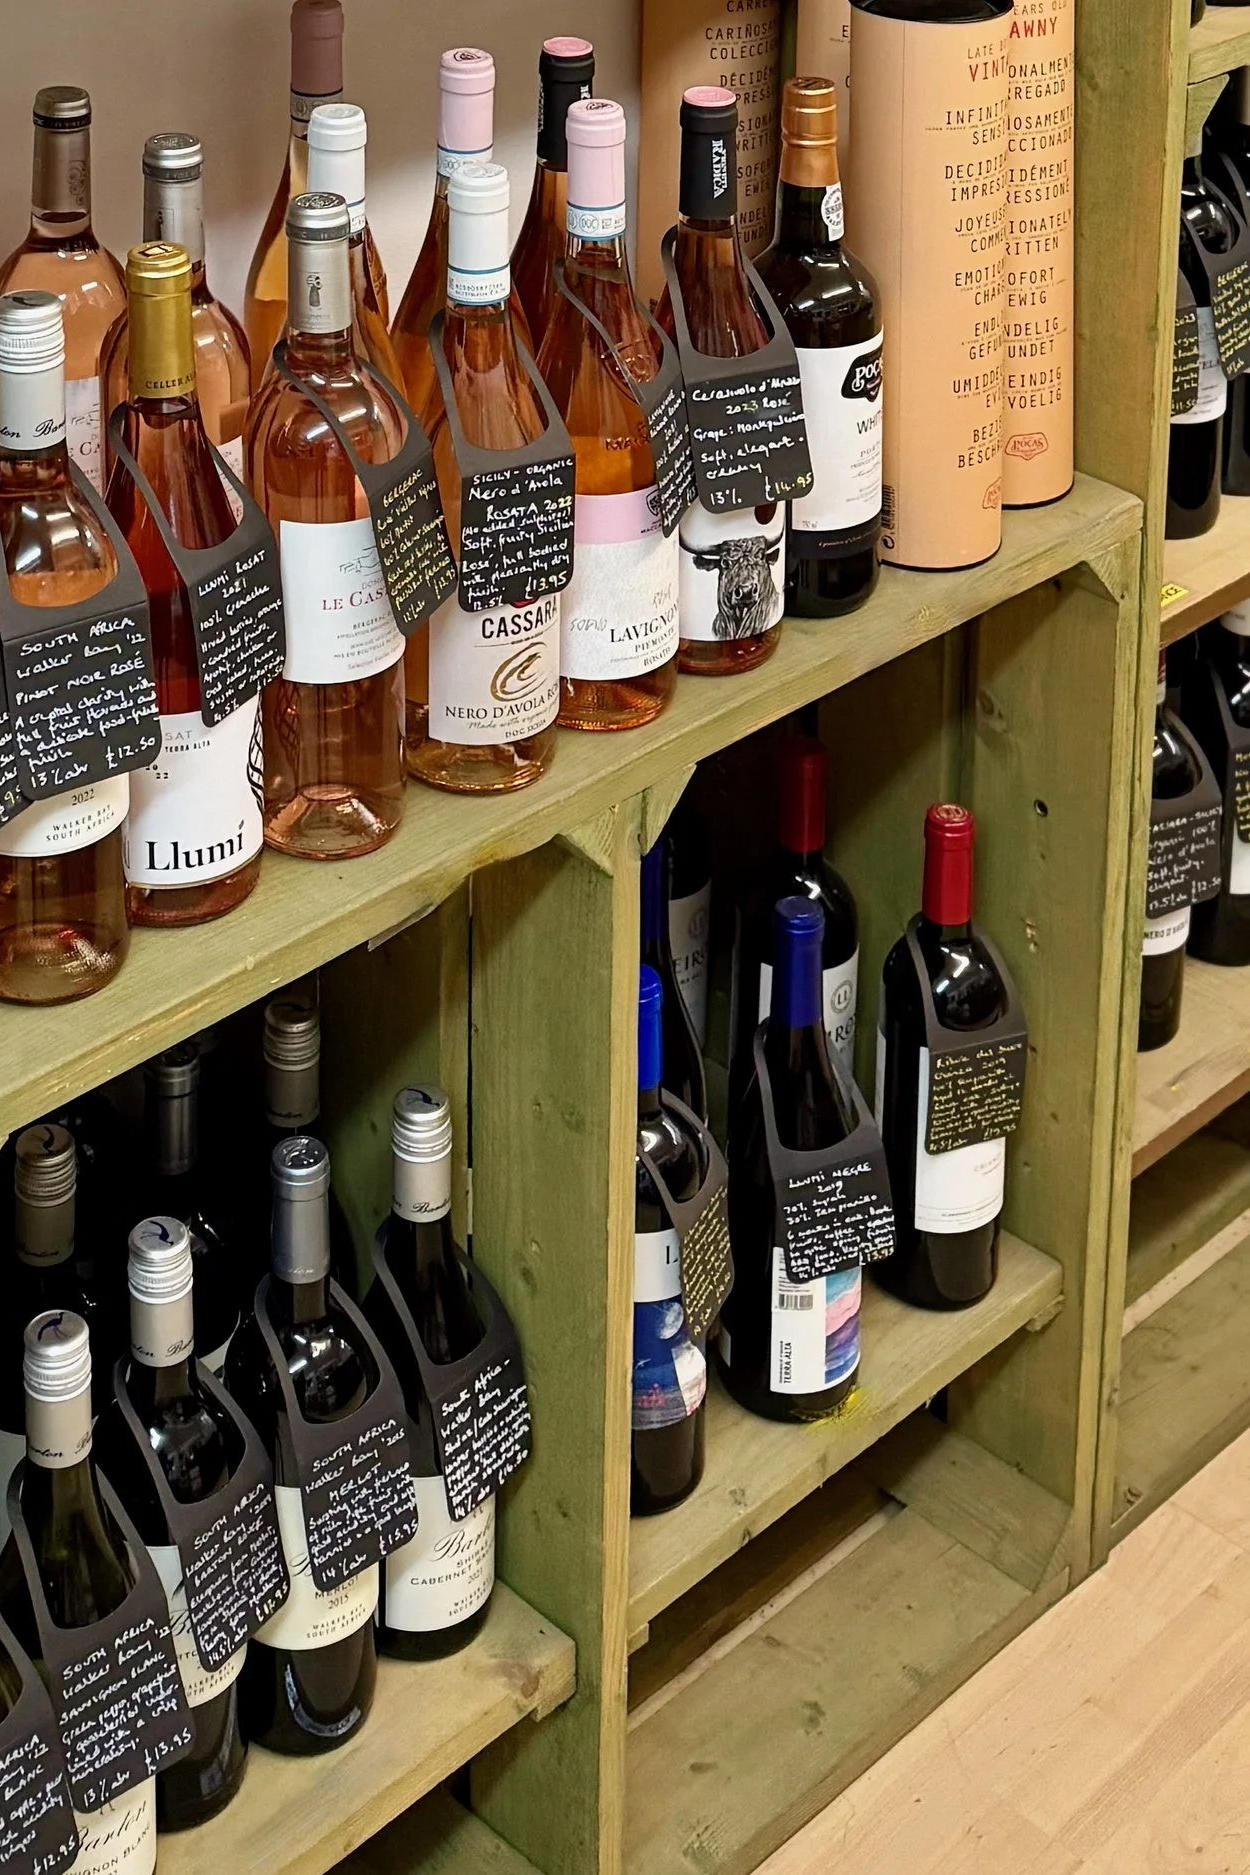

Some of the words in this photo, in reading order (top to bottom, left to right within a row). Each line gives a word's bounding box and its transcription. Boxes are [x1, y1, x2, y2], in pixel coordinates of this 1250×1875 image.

[968, 44, 994, 59] LATE
[726, 400, 758, 415] 2023
[473, 470, 510, 485] SICILY
[527, 459, 573, 475] ORGANIC
[469, 488, 507, 500] Nero
[764, 472, 812, 502] £14.95
[487, 503, 538, 522] ROSATA
[544, 496, 572, 511] 2022
[525, 571, 567, 599] £13.95
[321, 598, 344, 611] LE
[20, 633, 79, 657] SOUTH
[15, 685, 59, 706] PINOT
[67, 670, 106, 690] NOIR
[110, 651, 145, 676] ROSÉ
[445, 704, 488, 720] NERO
[105, 737, 156, 769] £12.50
[71, 788, 95, 806] 2022
[46, 829, 83, 842] SOUTH
[85, 812, 116, 830] AFRICA
[52, 813, 88, 832] WALKER
[817, 1180, 843, 1195] 2019
[312, 1443, 352, 1472] SOUTH
[358, 1419, 397, 1446] AFRICA
[329, 1462, 381, 1502] MERLOT
[194, 1515, 227, 1550] SOUTH
[380, 1519, 418, 1555] £15.95
[62, 1648, 107, 1680] SOUTH
[114, 1618, 154, 1649] AFRICA
